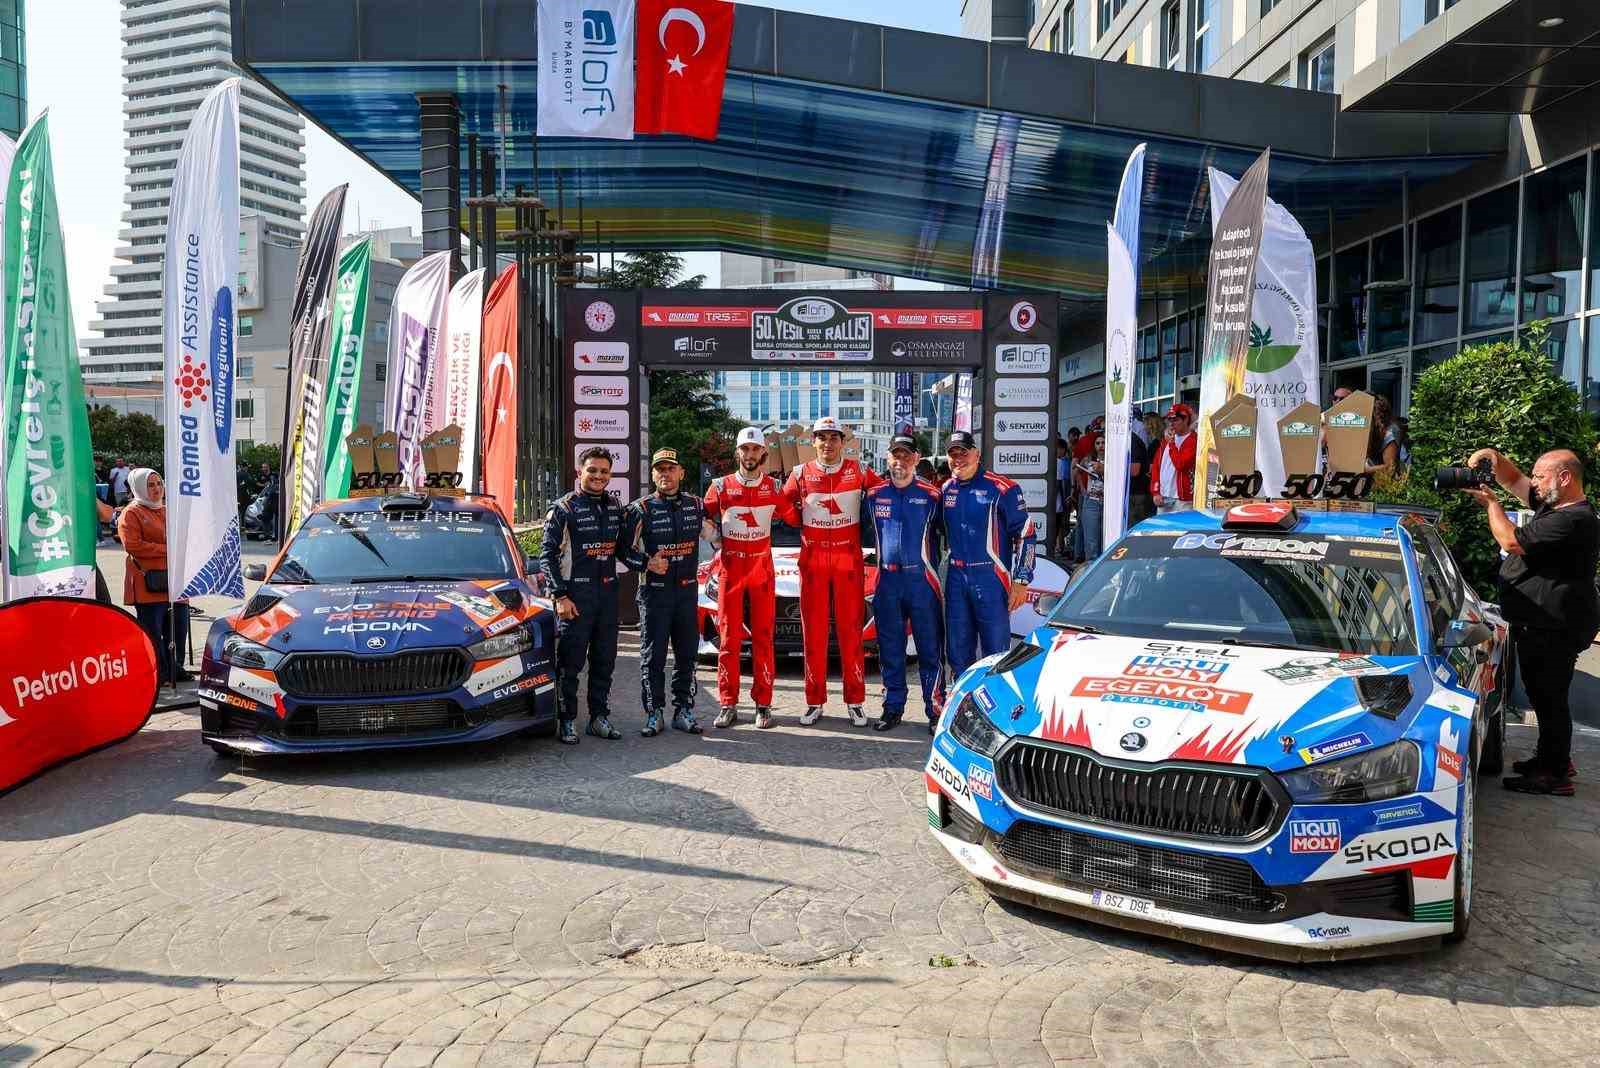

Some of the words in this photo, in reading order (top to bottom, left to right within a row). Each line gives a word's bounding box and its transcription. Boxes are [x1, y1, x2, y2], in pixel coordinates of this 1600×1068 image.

[564, 22, 573, 35] BY
[564, 41, 573, 104] MARRIOTT
[581, 10, 618, 117] aloft
[181, 232, 201, 350] Assistance
[755, 314, 775, 341] 50.
[674, 336, 720, 352] aloft
[1001, 346, 1048, 362] aloft
[179, 415, 202, 497] Remed
[1221, 470, 1264, 499] 50
[1281, 473, 1325, 499] 50
[1329, 471, 1375, 499] 50
[336, 511, 473, 525] NOTHING
[811, 518, 834, 527] Petrol
[835, 517, 852, 526] Ofisi
[728, 530, 751, 540] Petrol
[751, 530, 766, 539] Ofisi
[1111, 547, 1129, 560] 3
[327, 609, 438, 622] RACING
[1127, 665, 1220, 683] MOLY
[1134, 656, 1226, 673] LIQUI
[13, 660, 79, 708] Petrol
[82, 648, 129, 685] Ofisi
[493, 673, 552, 699] EVOFONE
[206, 688, 258, 712] EVOFONE
[1083, 679, 1240, 705] EGEMOT
[1320, 737, 1362, 754] MICHELIN
[970, 763, 992, 783] LIQUI
[1379, 807, 1418, 820] RAVENOL
[1292, 821, 1337, 837] LIQUI
[1293, 837, 1339, 850] MOLY
[1104, 893, 1124, 909] 8SZ
[1129, 899, 1151, 914] D9E
